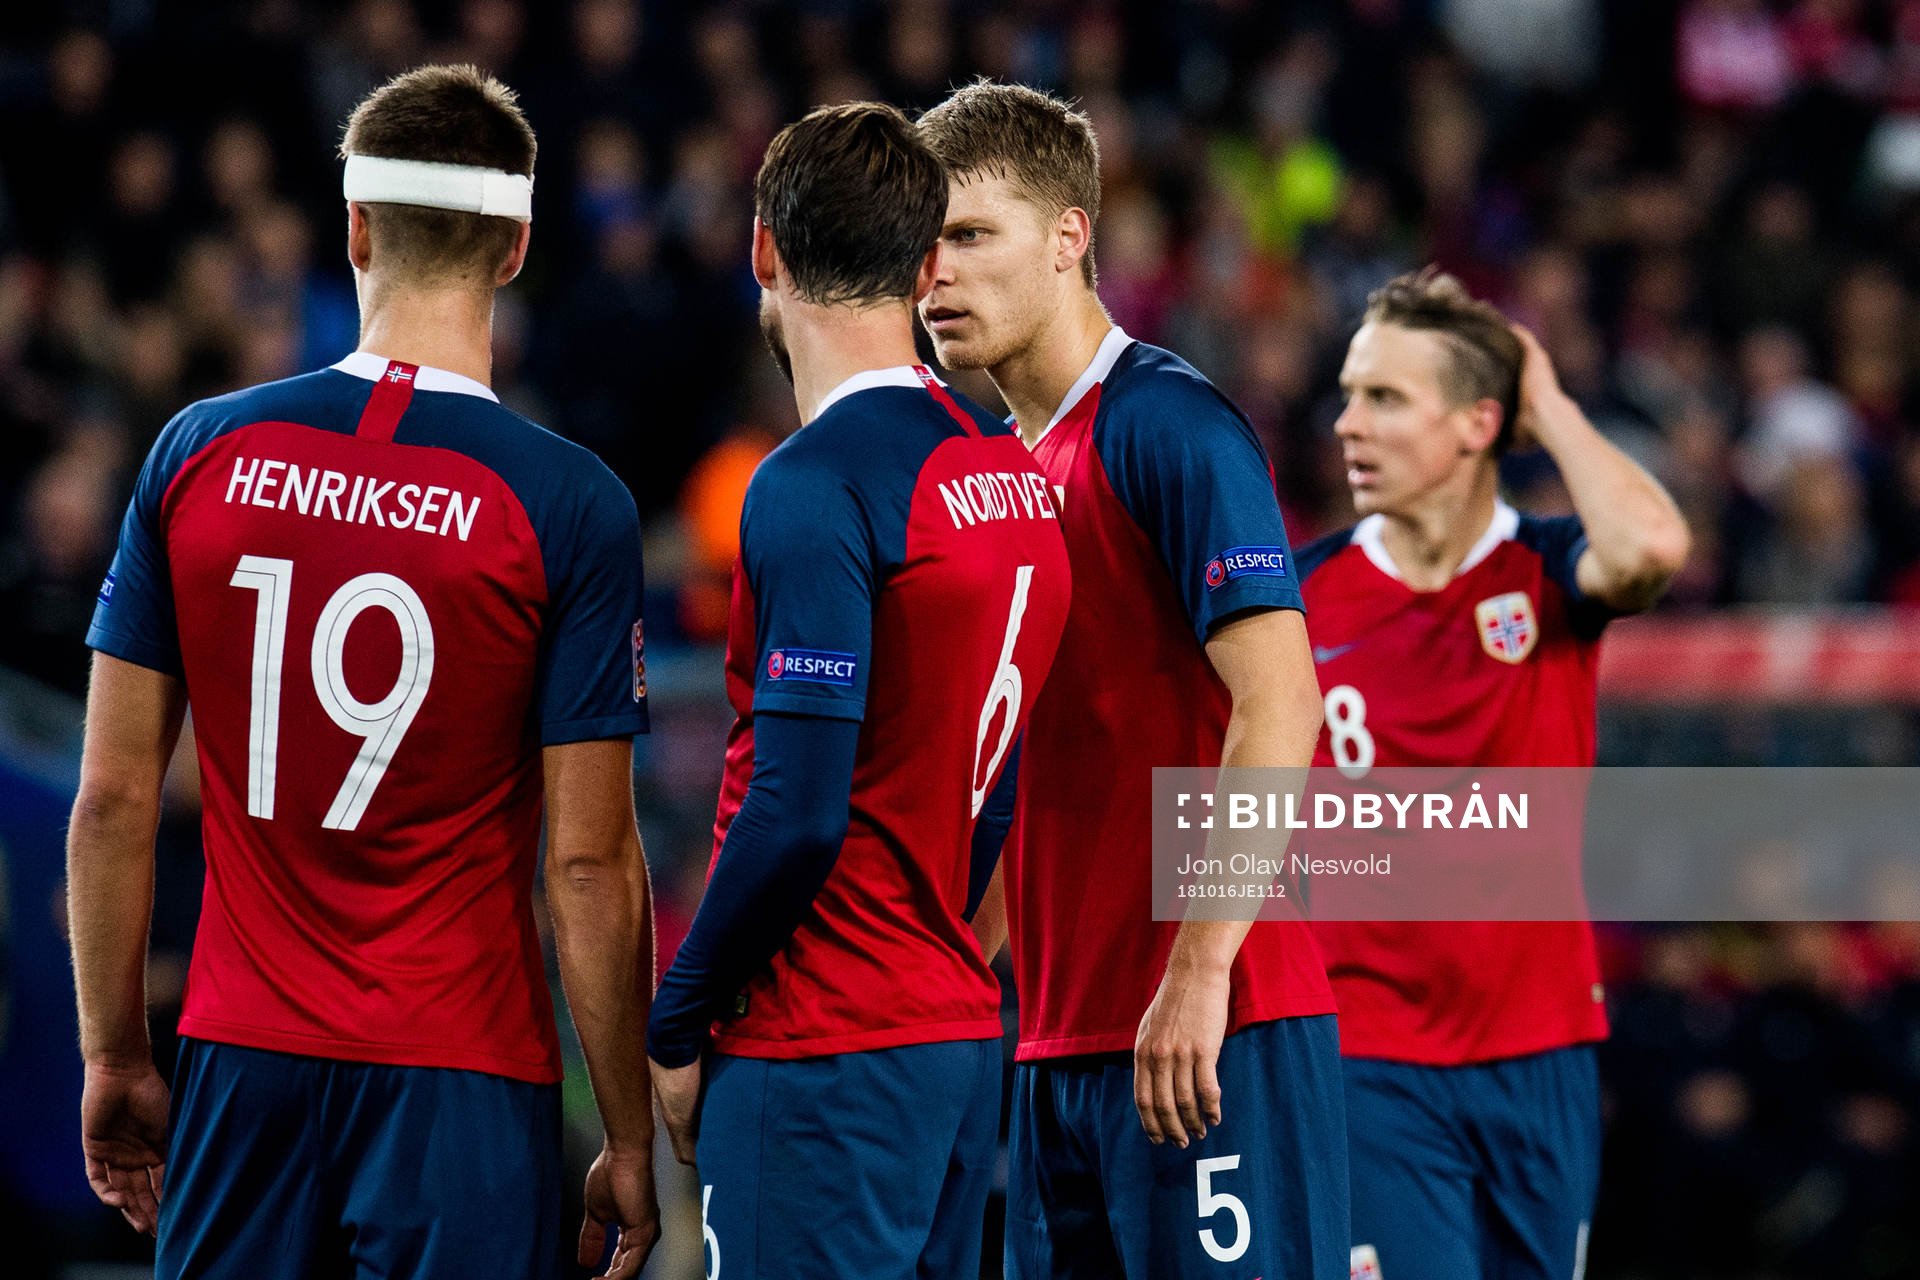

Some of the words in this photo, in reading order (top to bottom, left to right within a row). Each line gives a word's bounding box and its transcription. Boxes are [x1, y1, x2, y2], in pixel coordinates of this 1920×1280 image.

[225, 457, 481, 541] HENRIKSEN
[1225, 554, 1283, 572] RESPECT
[229, 554, 435, 831] 19
[785, 657, 855, 677] RESPECT
[971, 565, 1035, 820] 6
[1324, 684, 1376, 780] 8
[1196, 1154, 1251, 1262] 5
